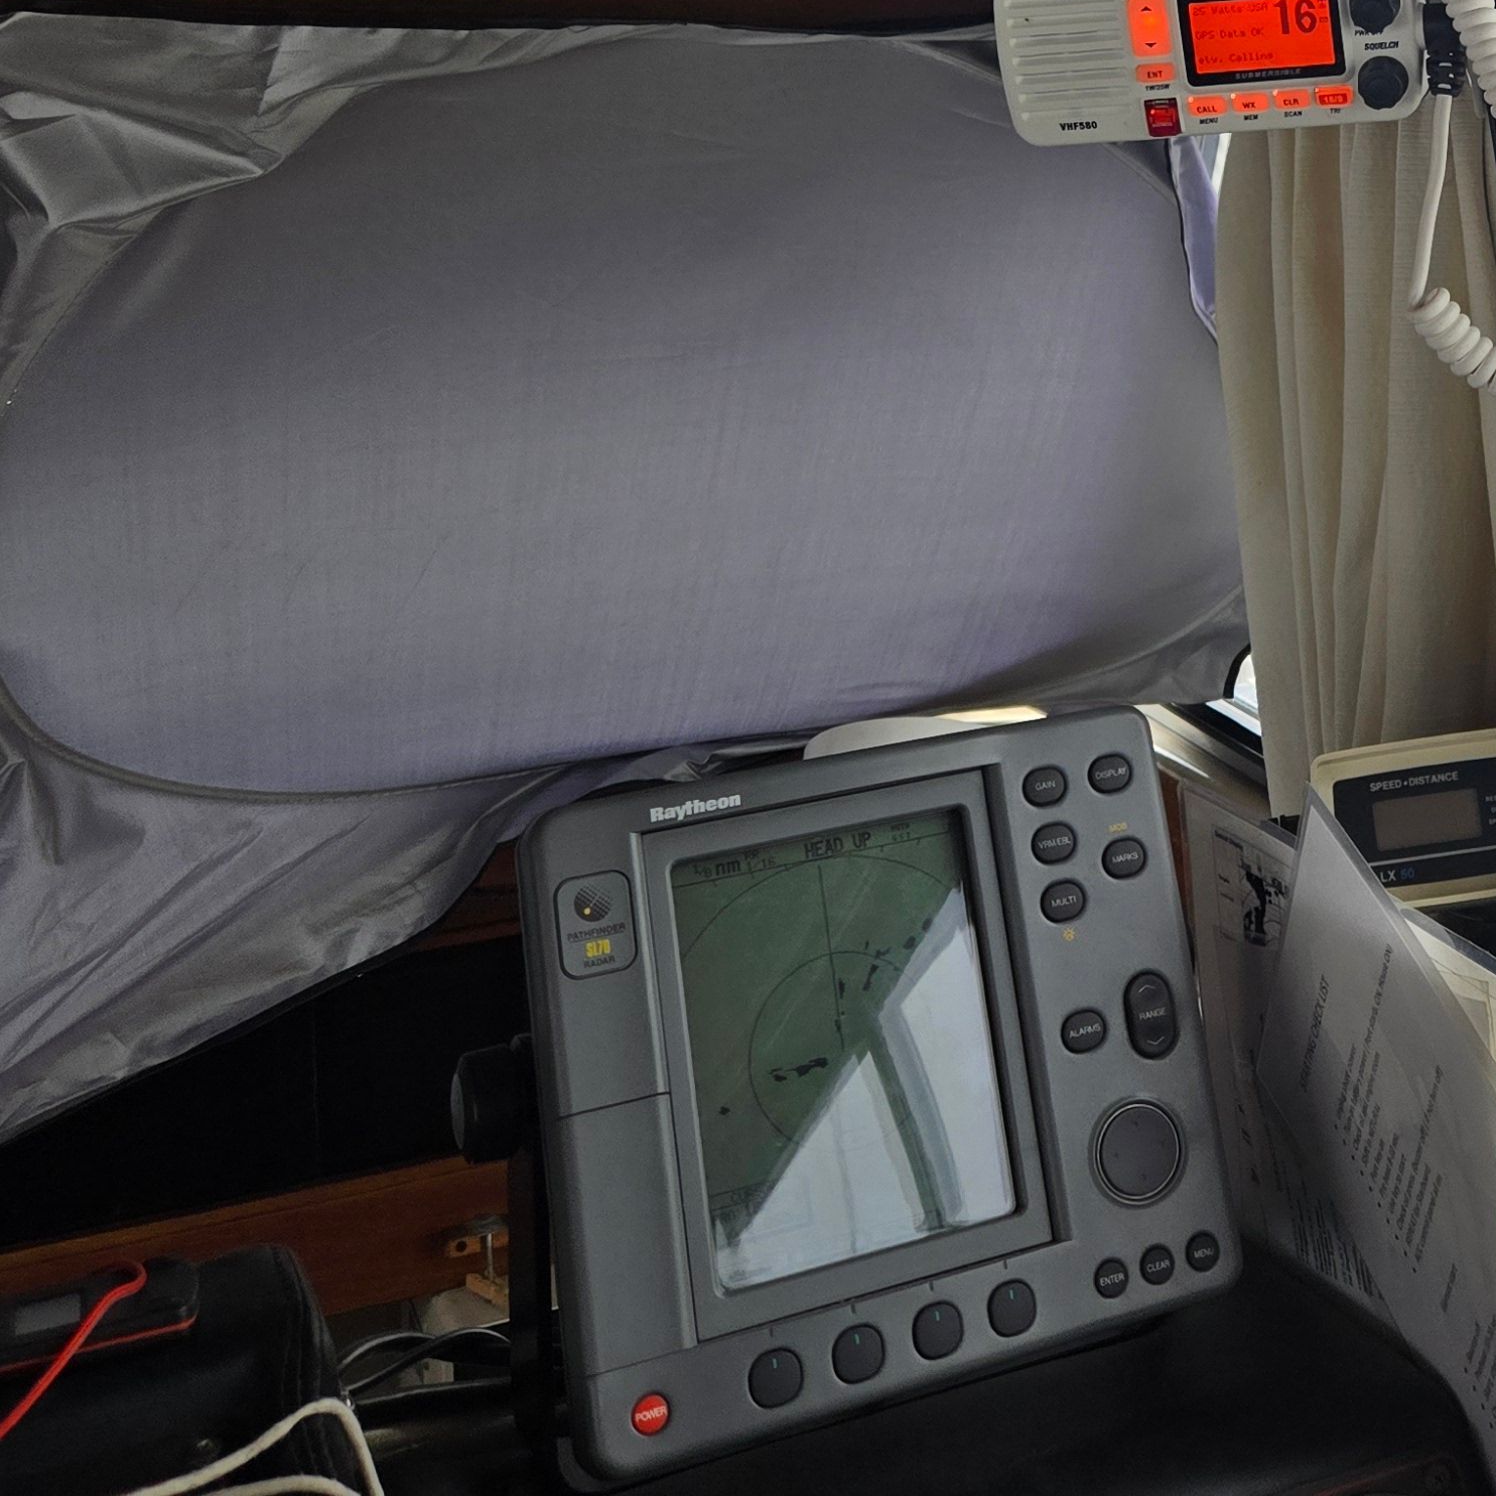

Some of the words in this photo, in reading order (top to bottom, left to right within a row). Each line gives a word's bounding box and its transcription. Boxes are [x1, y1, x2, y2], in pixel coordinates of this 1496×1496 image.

[1364, 40, 1399, 51] SQUELCH
[1196, 105, 1218, 114] CALL
[1058, 120, 1098, 132] VHF580
[1199, 117, 1219, 125] MENU
[1095, 767, 1127, 780] DISPLAY
[1034, 780, 1057, 792] GAIN
[1369, 779, 1403, 792] SPEED
[1408, 771, 1460, 787] DISTANCE
[649, 795, 741, 823] Raytheon
[804, 839, 845, 859] HEAD
[851, 831, 871, 849] UP
[1112, 852, 1139, 864] MARKS
[1381, 869, 1397, 883] LX
[1051, 895, 1077, 908] MULTI
[567, 922, 626, 942] PATHFINDER
[1138, 1007, 1167, 1020] RANGE
[1069, 1023, 1101, 1039] ALARMS
[1146, 1259, 1171, 1273] CLEAR
[1099, 1272, 1125, 1287] ENTER
[635, 1405, 668, 1423] POWER
